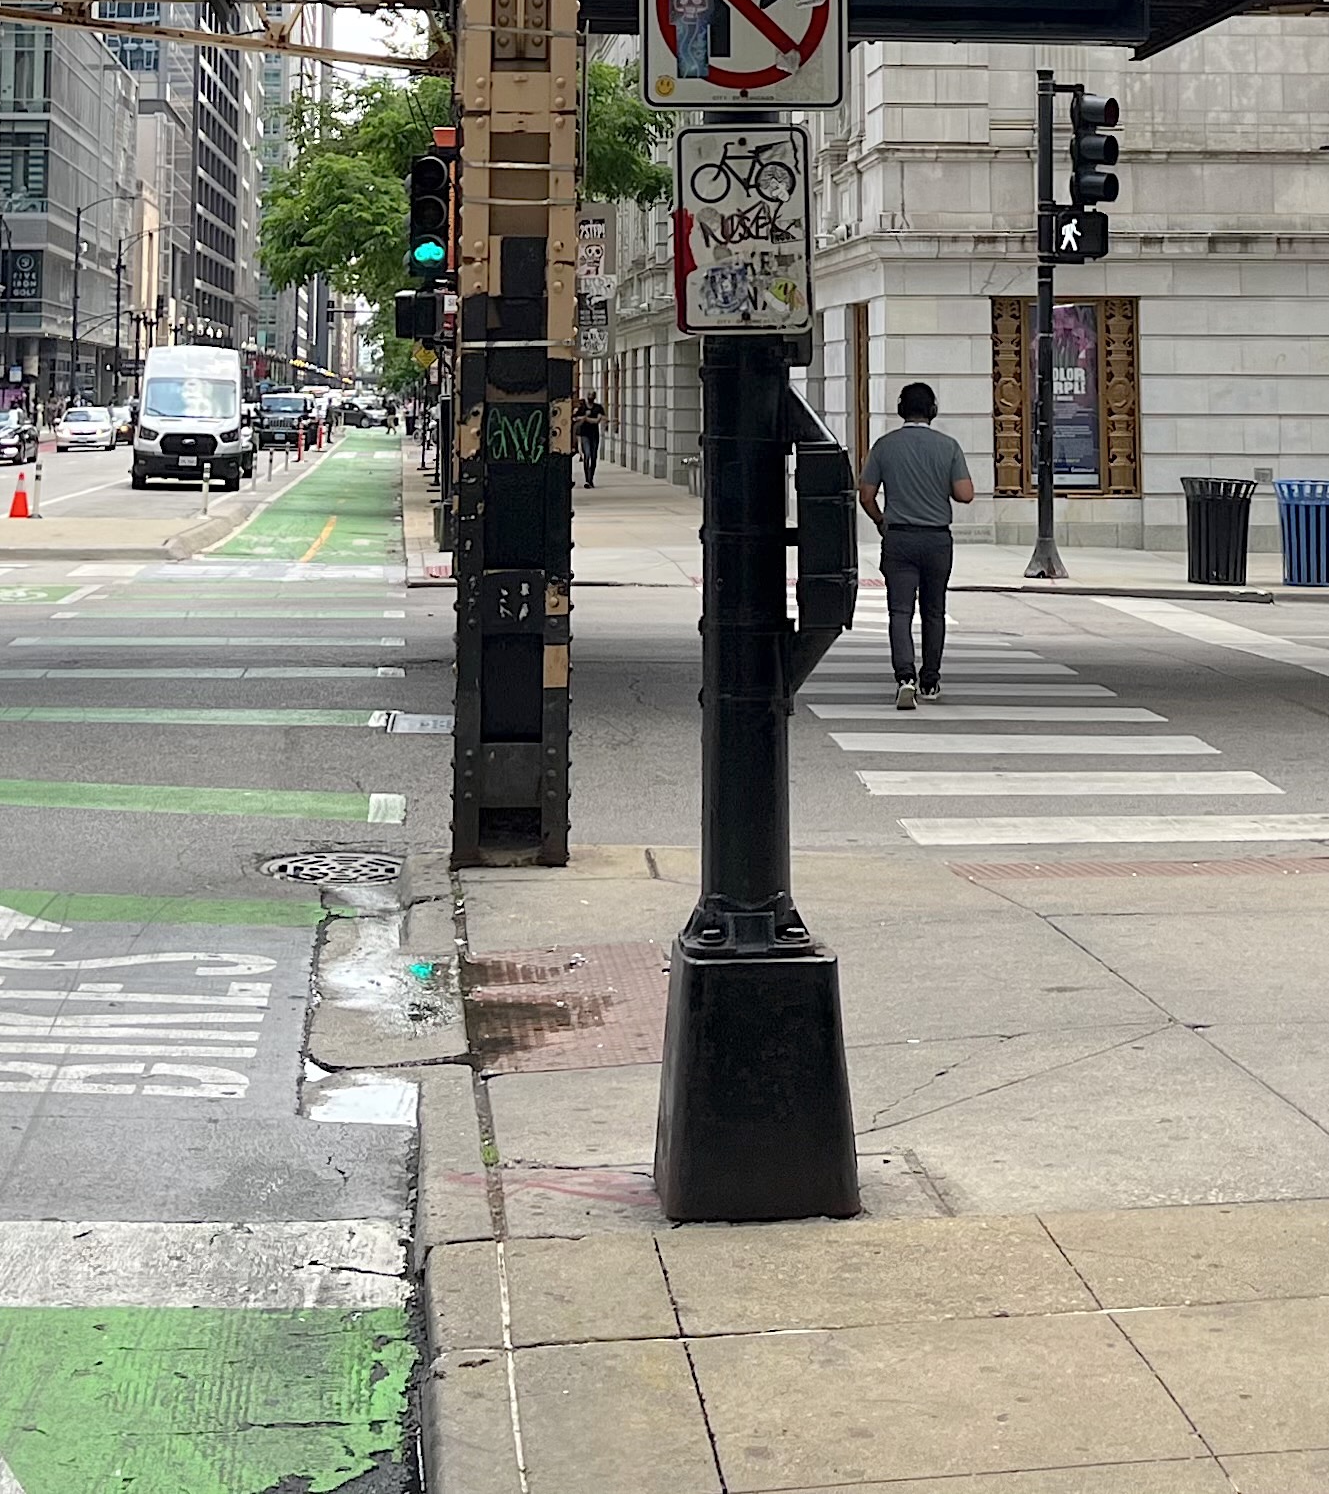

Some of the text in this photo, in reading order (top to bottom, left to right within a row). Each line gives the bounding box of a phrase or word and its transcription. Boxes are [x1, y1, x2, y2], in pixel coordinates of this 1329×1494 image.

[13, 272, 36, 280] FIVE
[1053, 368, 1086, 382] OLOR
[1053, 382, 1086, 395] RPLE
